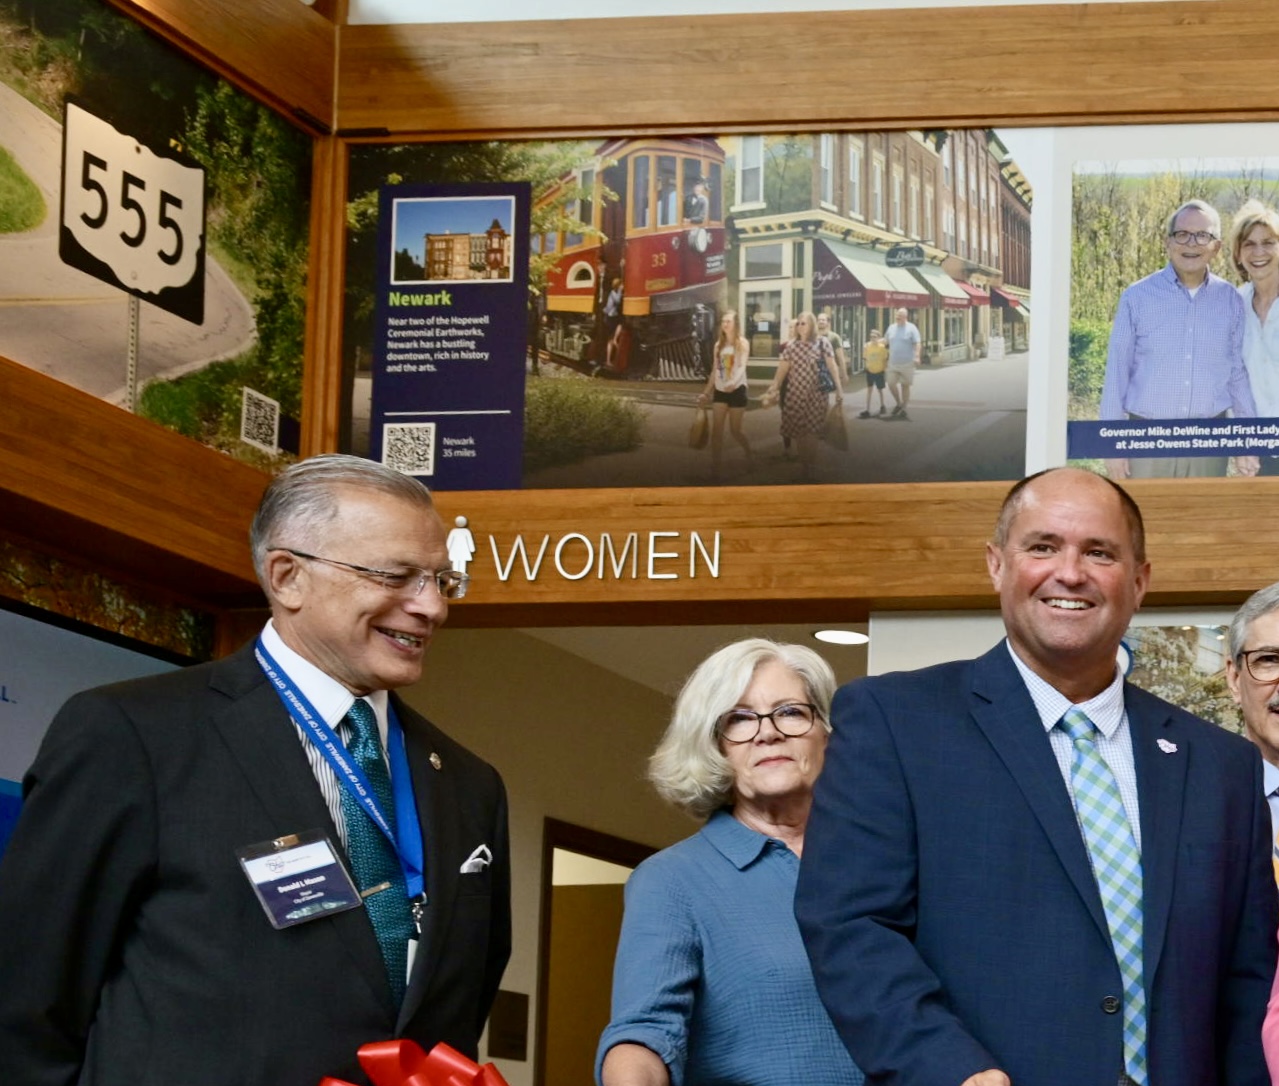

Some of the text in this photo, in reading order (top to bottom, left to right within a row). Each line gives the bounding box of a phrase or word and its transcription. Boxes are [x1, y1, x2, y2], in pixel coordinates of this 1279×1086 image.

[80, 150, 184, 266] 555
[389, 290, 451, 306] Newark
[388, 315, 490, 326] Near two of the Hopewell
[387, 327, 485, 338] Ceremonial Earthworks,
[387, 339, 419, 349] Newark
[420, 339, 434, 349] has
[442, 339, 476, 350] bustling
[386, 350, 490, 361] downtown, rich in history
[386, 363, 438, 372] and the arts.
[1099, 427, 1146, 437] Governor
[1147, 426, 1171, 436] Mike
[1173, 425, 1210, 436] DeWine
[1212, 425, 1231, 435] and
[1233, 424, 1255, 435] First
[443, 437, 475, 446] Newark
[1116, 440, 1127, 449] at
[1128, 440, 1155, 449] Jesse
[1156, 439, 1191, 449] Owens
[1192, 438, 1219, 448] State
[1220, 438, 1244, 447] Park
[489, 531, 720, 581] WOMEN
